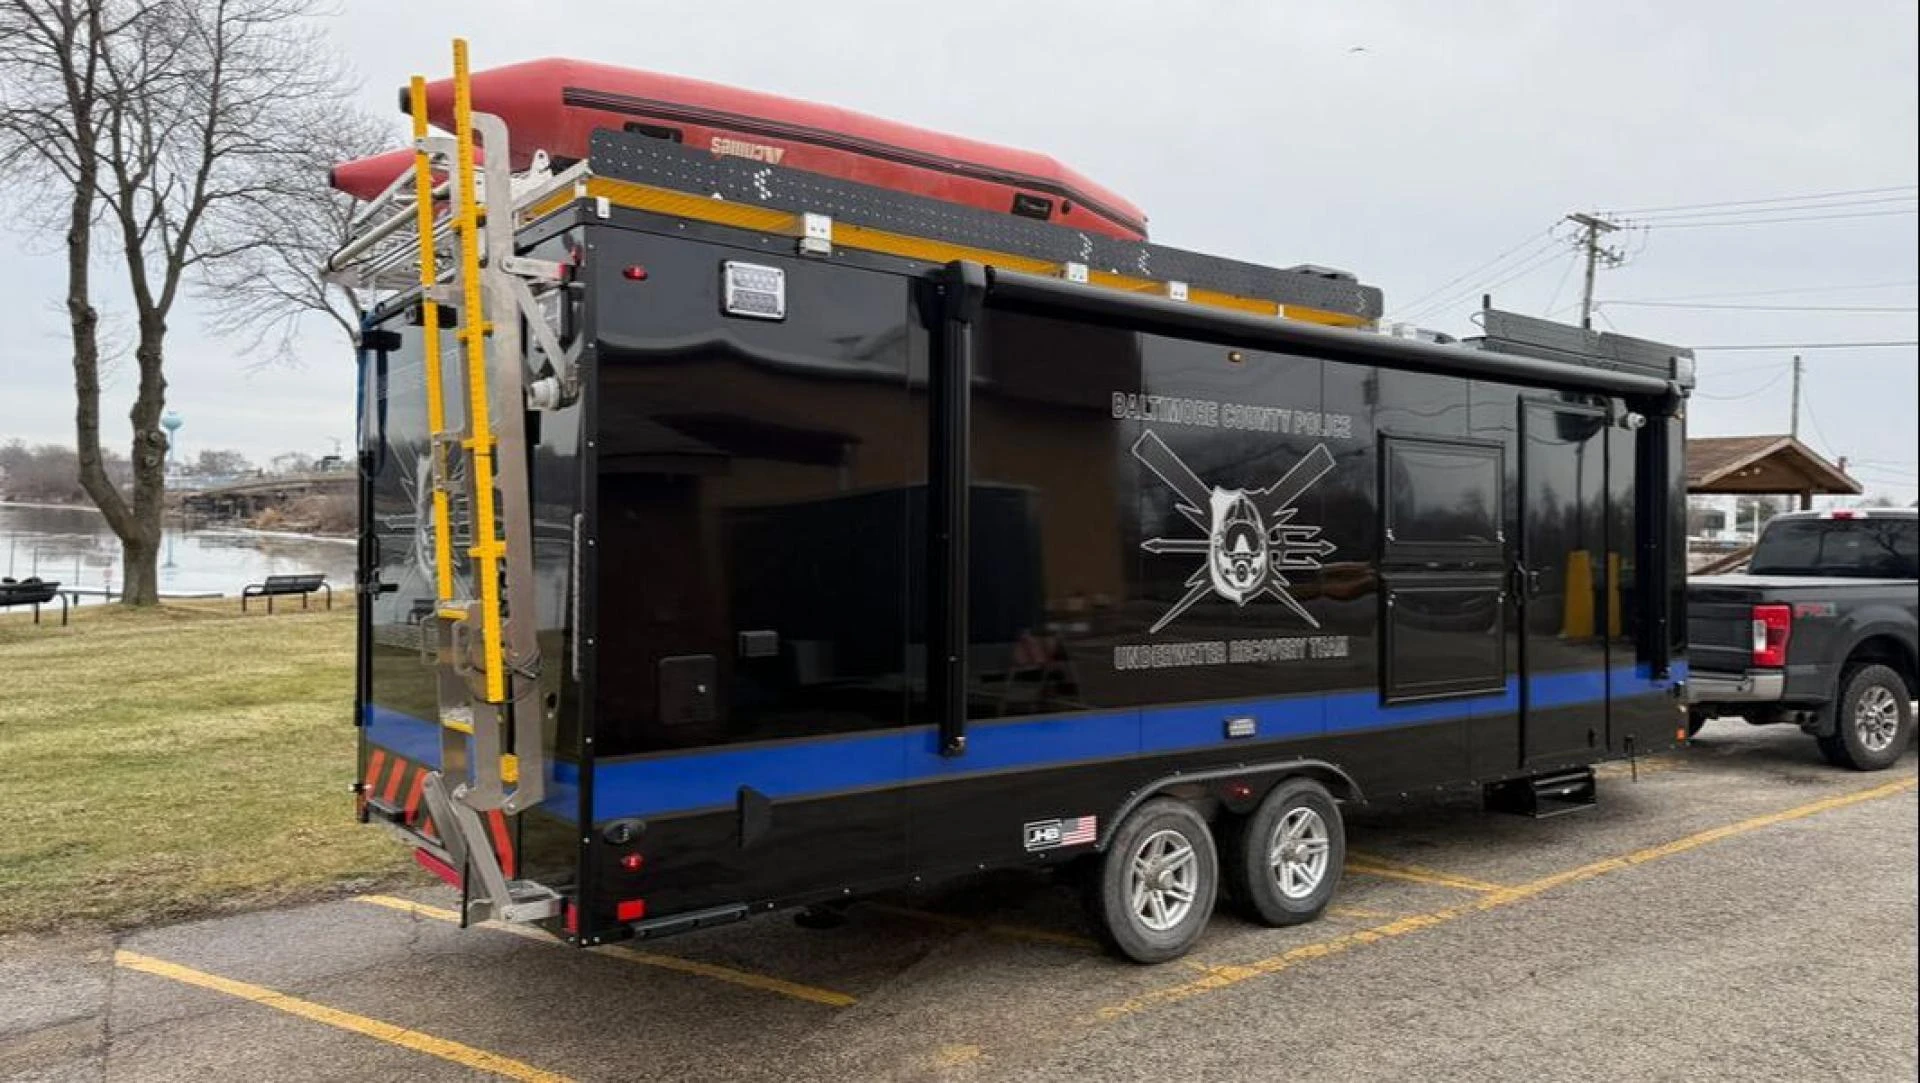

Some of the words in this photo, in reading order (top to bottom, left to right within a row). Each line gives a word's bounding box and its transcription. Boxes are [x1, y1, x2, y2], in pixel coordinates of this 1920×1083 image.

[1111, 391, 1219, 428] BALTIMORE
[1221, 403, 1292, 432] COUNTY
[1293, 410, 1352, 438] POLICE
[1114, 642, 1227, 670] UNDERWATER
[1229, 637, 1306, 663] RECOVERY
[1310, 636, 1349, 658] TEAM
